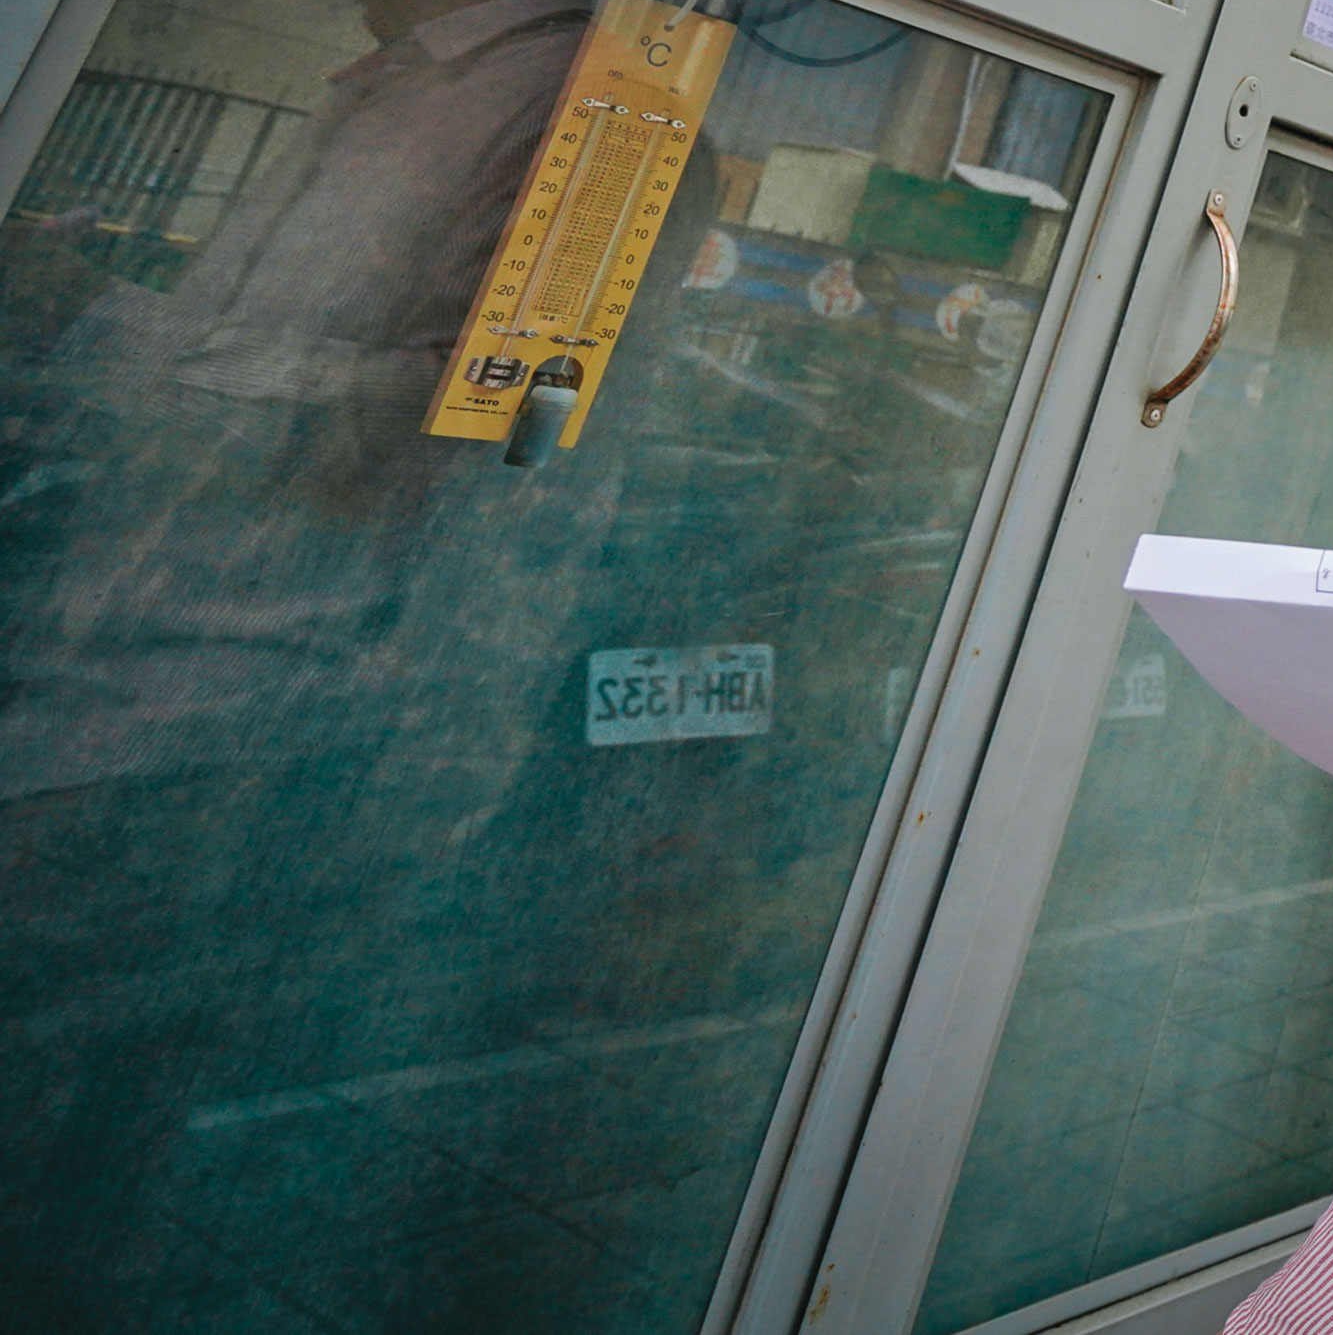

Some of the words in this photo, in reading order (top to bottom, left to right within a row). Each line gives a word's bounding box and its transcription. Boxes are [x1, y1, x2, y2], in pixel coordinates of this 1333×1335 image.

[571, 106, 589, 119] 50
[560, 131, 578, 144] 40
[671, 131, 687, 144] 50
[549, 156, 568, 169] 30
[662, 154, 679, 168] 40
[539, 181, 558, 194] 20
[652, 179, 669, 192] 30
[531, 208, 547, 221] 10
[643, 204, 660, 216] 20
[523, 234, 533, 246] 0
[633, 228, 649, 240] 10
[503, 259, 526, 272] -10
[625, 254, 635, 265] 0
[493, 284, 516, 297] -20
[614, 278, 635, 290] -10
[604, 303, 626, 316] -20
[481, 310, 505, 323] -30
[594, 328, 617, 341] -30
[473, 398, 500, 407] SATO
